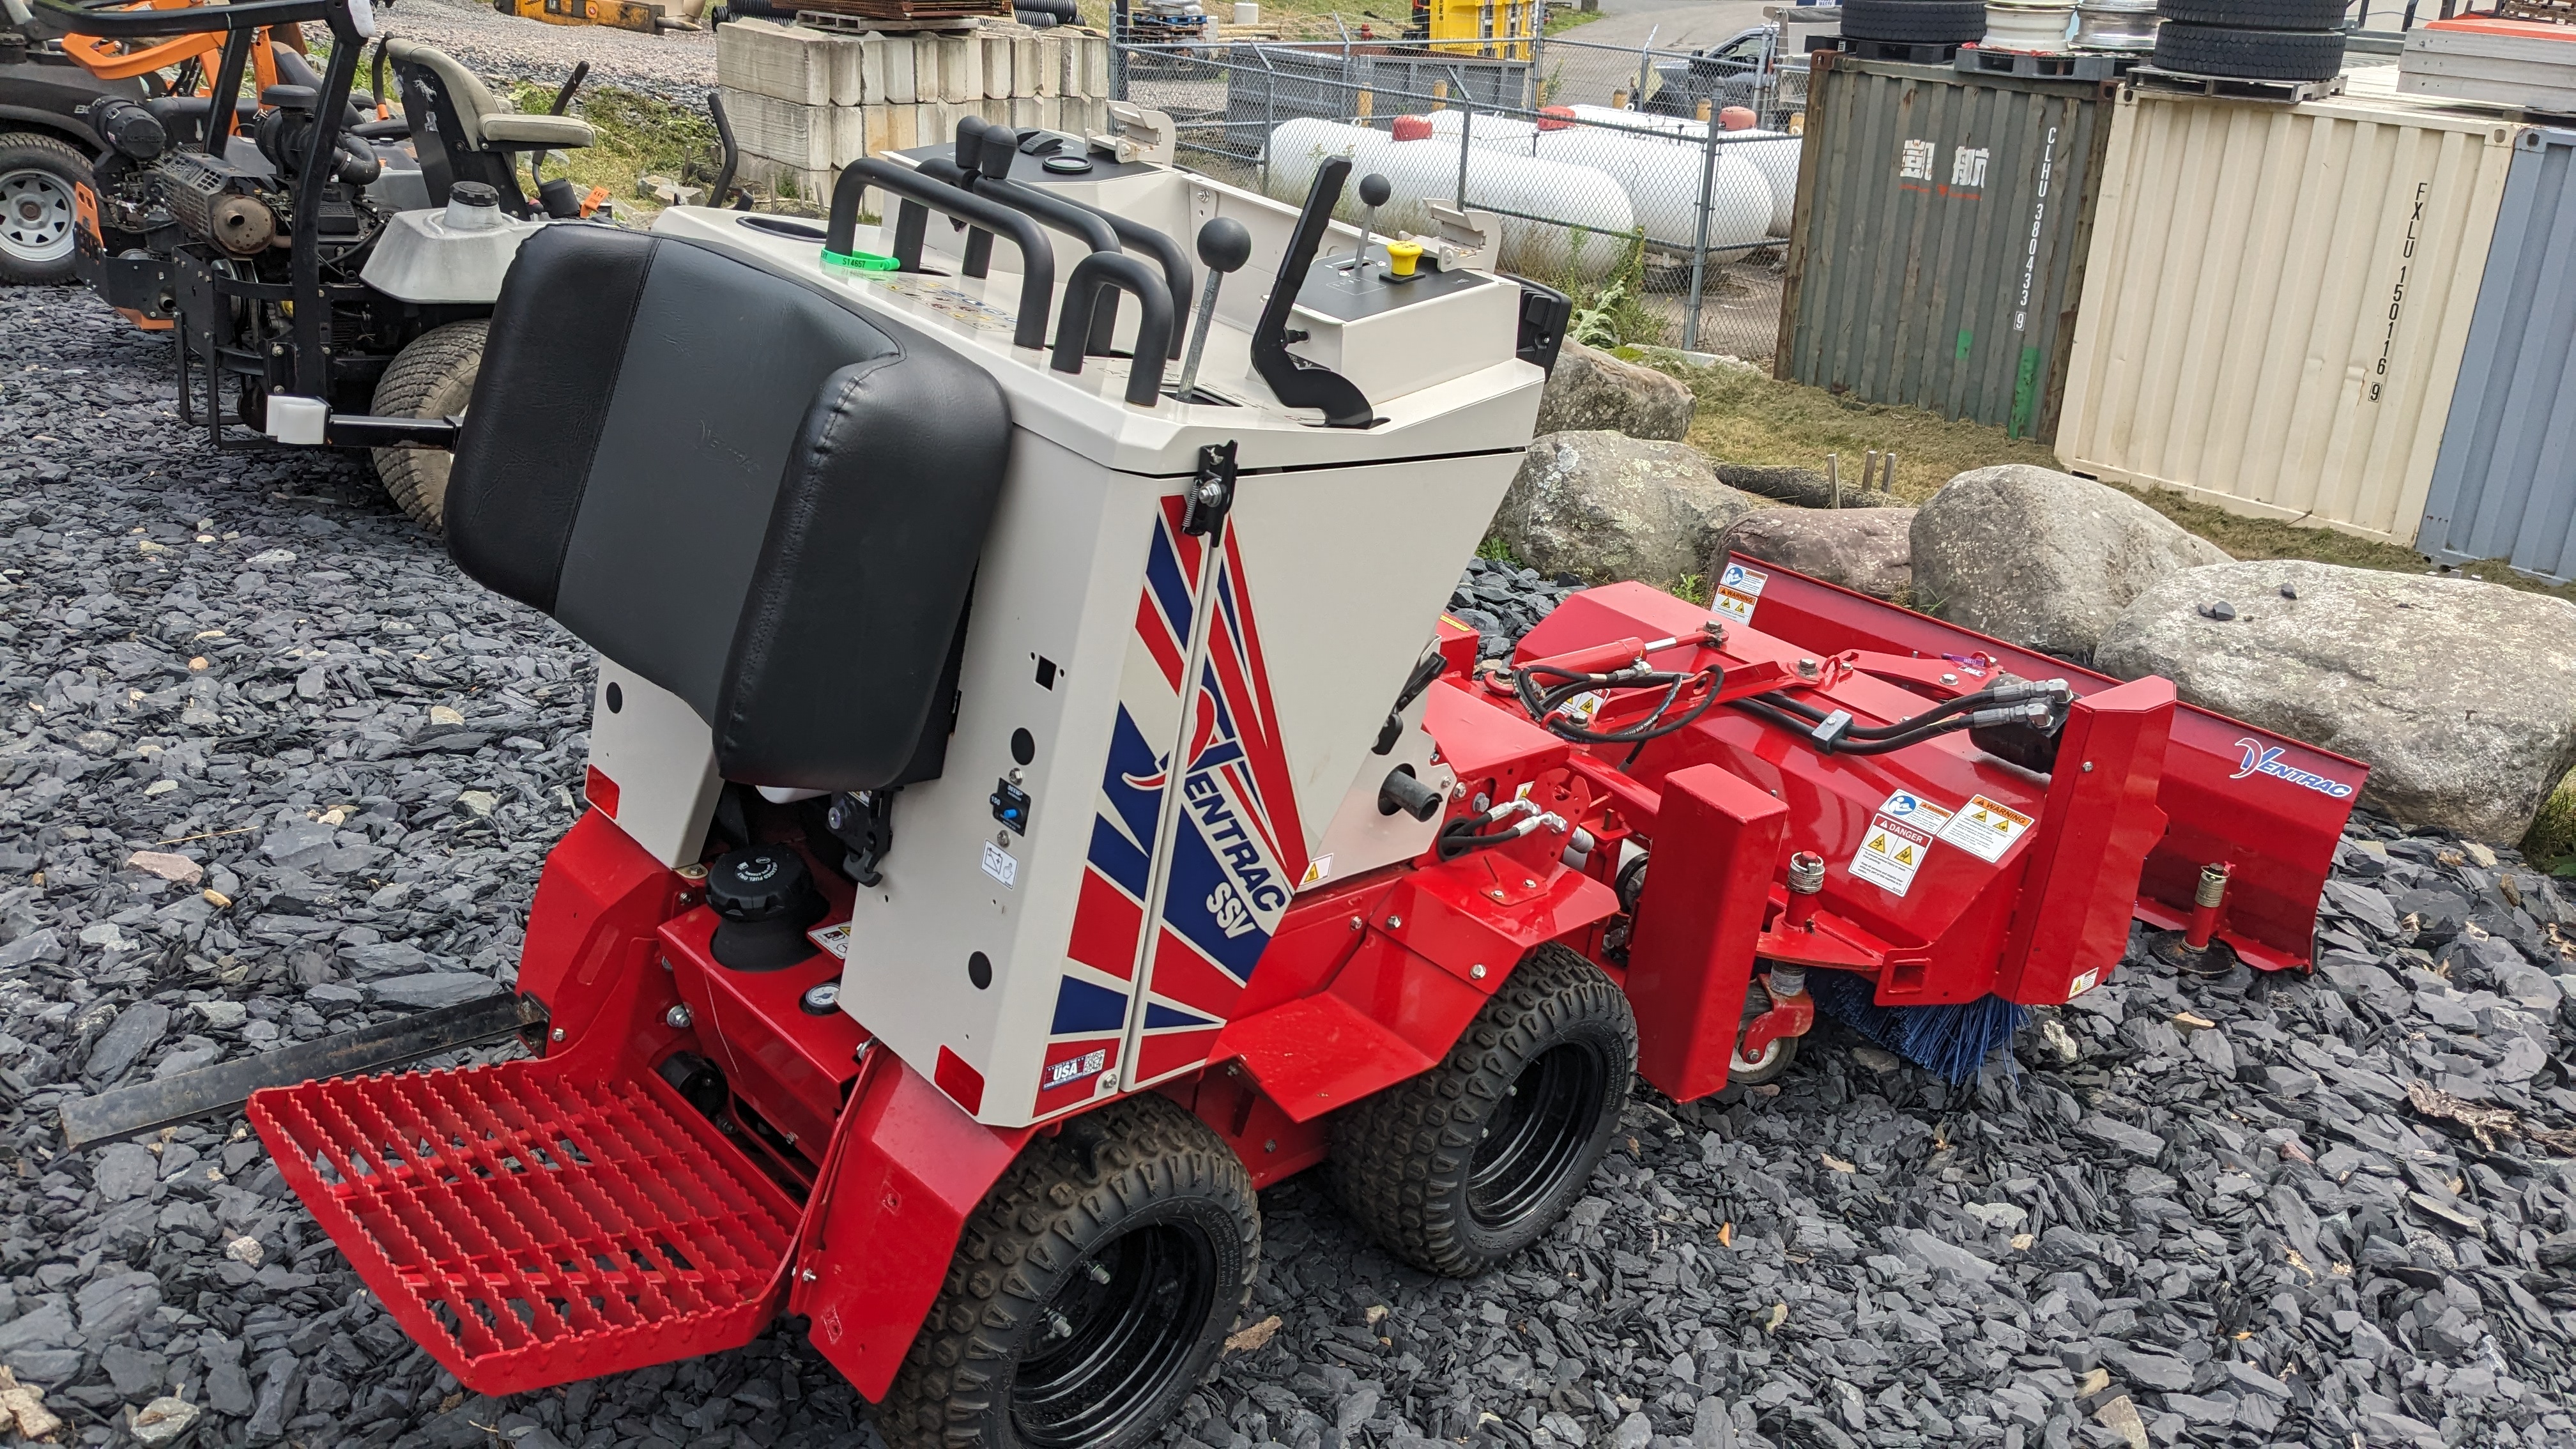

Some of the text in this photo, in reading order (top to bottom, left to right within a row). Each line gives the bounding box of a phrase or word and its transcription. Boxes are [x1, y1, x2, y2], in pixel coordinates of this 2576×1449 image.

[2014, 126, 2058, 329] CLHU 380433 9
[842, 257, 866, 269] S14657
[2370, 181, 2428, 401] FXLU 150116 9
[1727, 590, 1753, 604] WARNING
[2230, 738, 2352, 797] VENTRAC
[1986, 802, 2027, 824] WARNING
[1889, 824, 1923, 843] DANGER
[1206, 882, 1256, 939] SSV
[1053, 1062, 1078, 1082] USA
